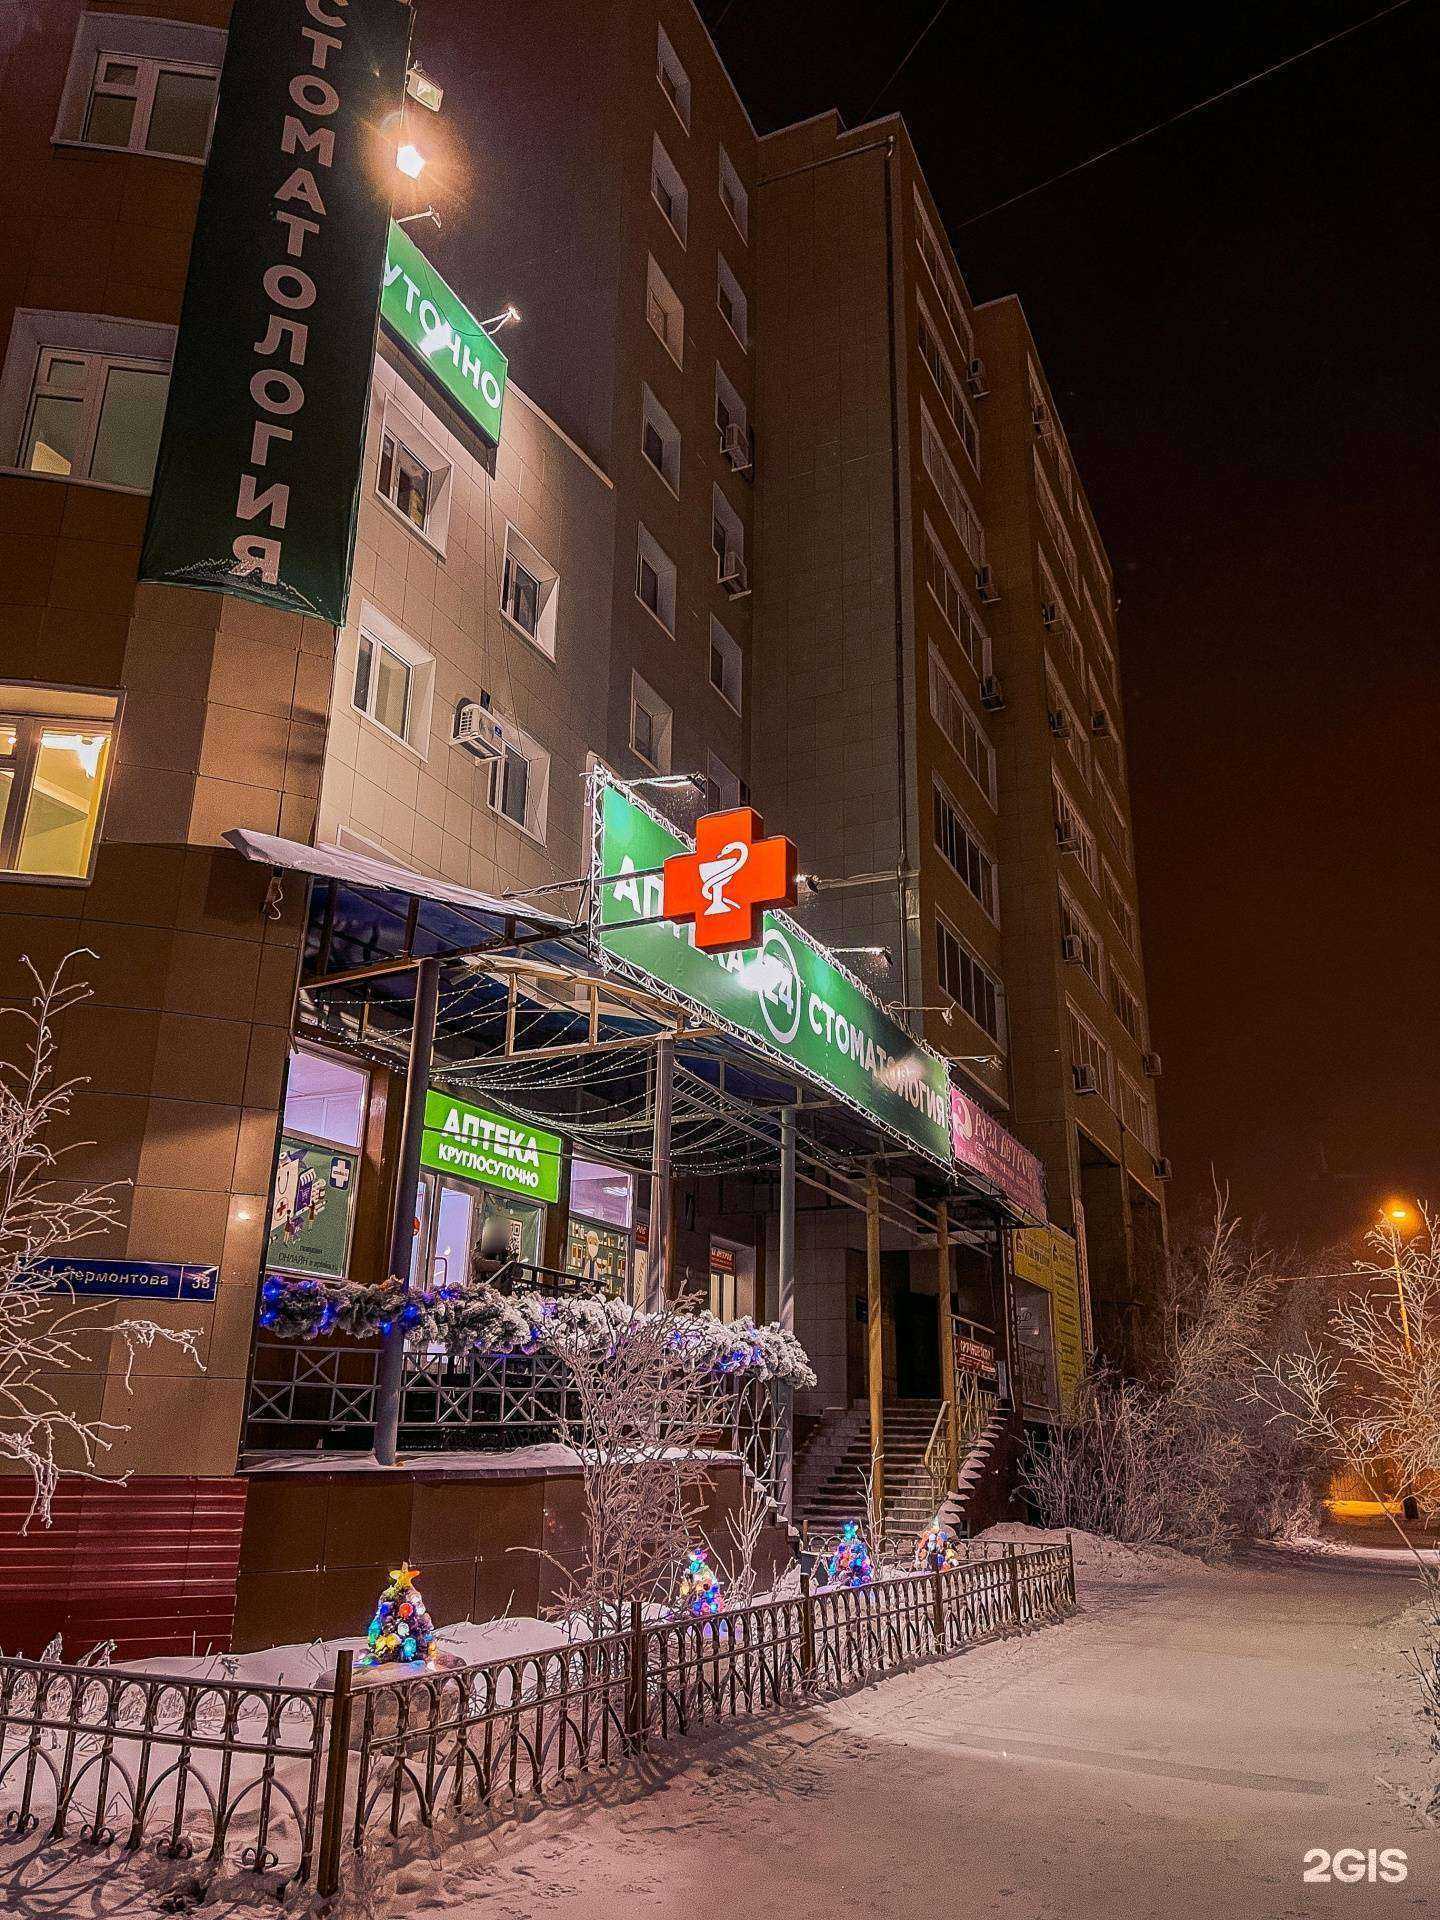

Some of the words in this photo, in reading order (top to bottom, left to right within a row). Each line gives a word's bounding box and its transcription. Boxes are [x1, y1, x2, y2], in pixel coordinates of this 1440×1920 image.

[232, 0, 348, 585] СТОМАТОЛОГИЯ
[438, 1142, 539, 1188] КРУГЛОСУТОЧНО
[441, 1107, 540, 1168] АПТЕКА
